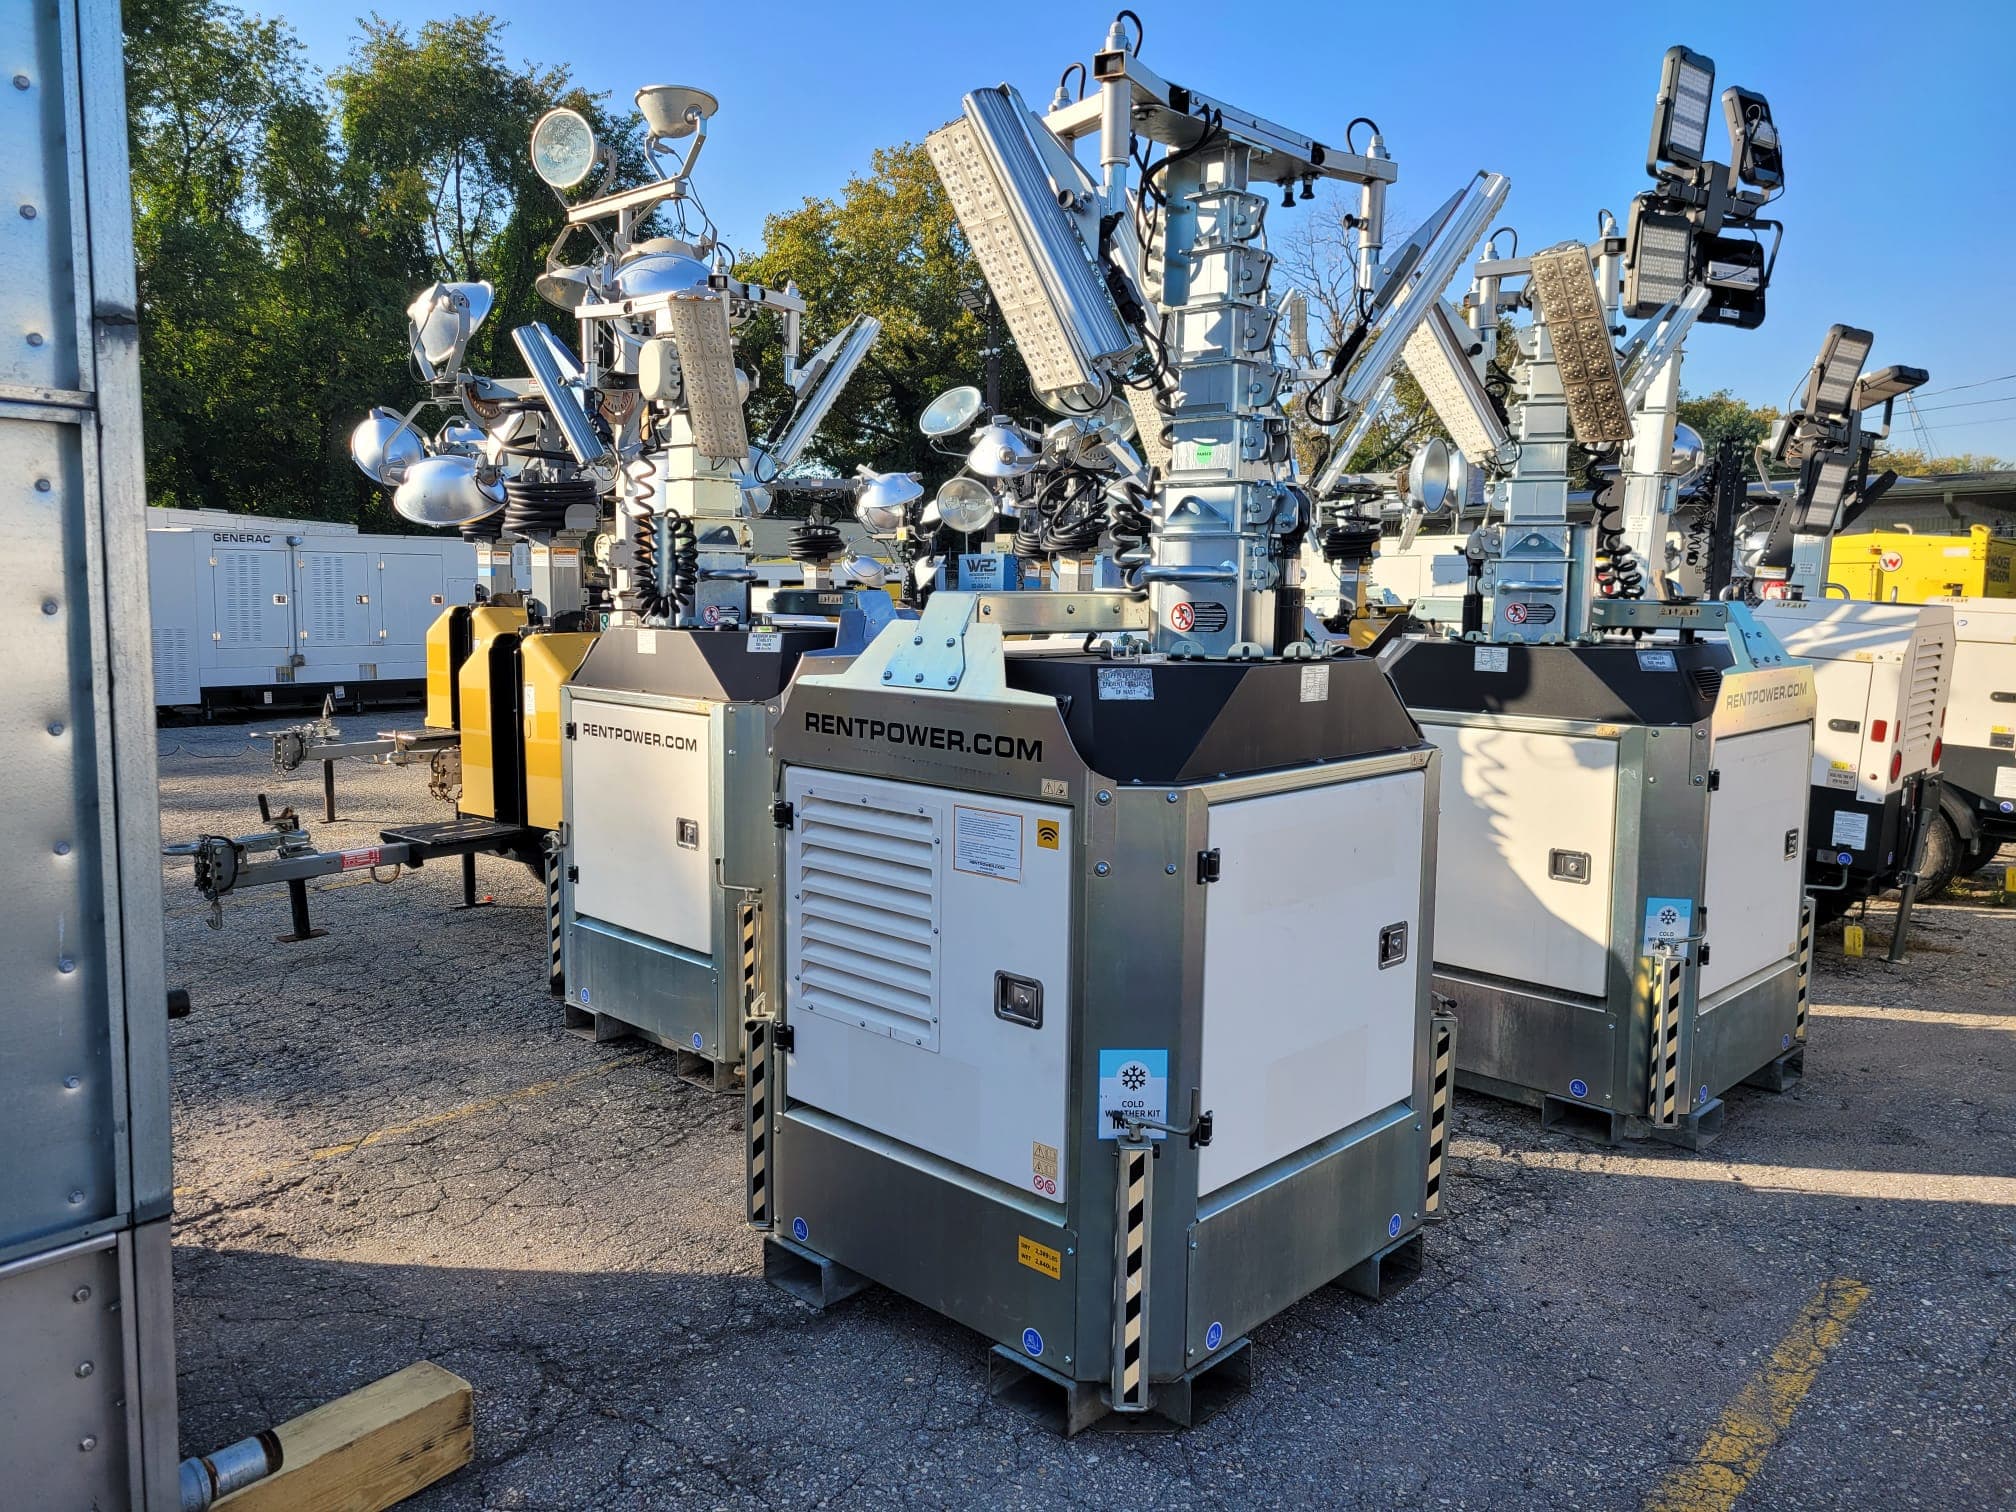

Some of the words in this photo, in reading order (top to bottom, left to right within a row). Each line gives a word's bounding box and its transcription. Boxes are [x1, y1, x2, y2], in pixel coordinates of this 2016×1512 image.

[213, 533, 271, 544] GENERAC
[1726, 682, 1808, 710] RENTPOWER.COM
[583, 722, 697, 752] RENTPOWER.COM
[805, 711, 1043, 763] RENTPOWER.COM
[1105, 1109, 1146, 1118] WTHER
[1147, 1109, 1161, 1118] KIT
[1121, 1100, 1144, 1108] COLD
